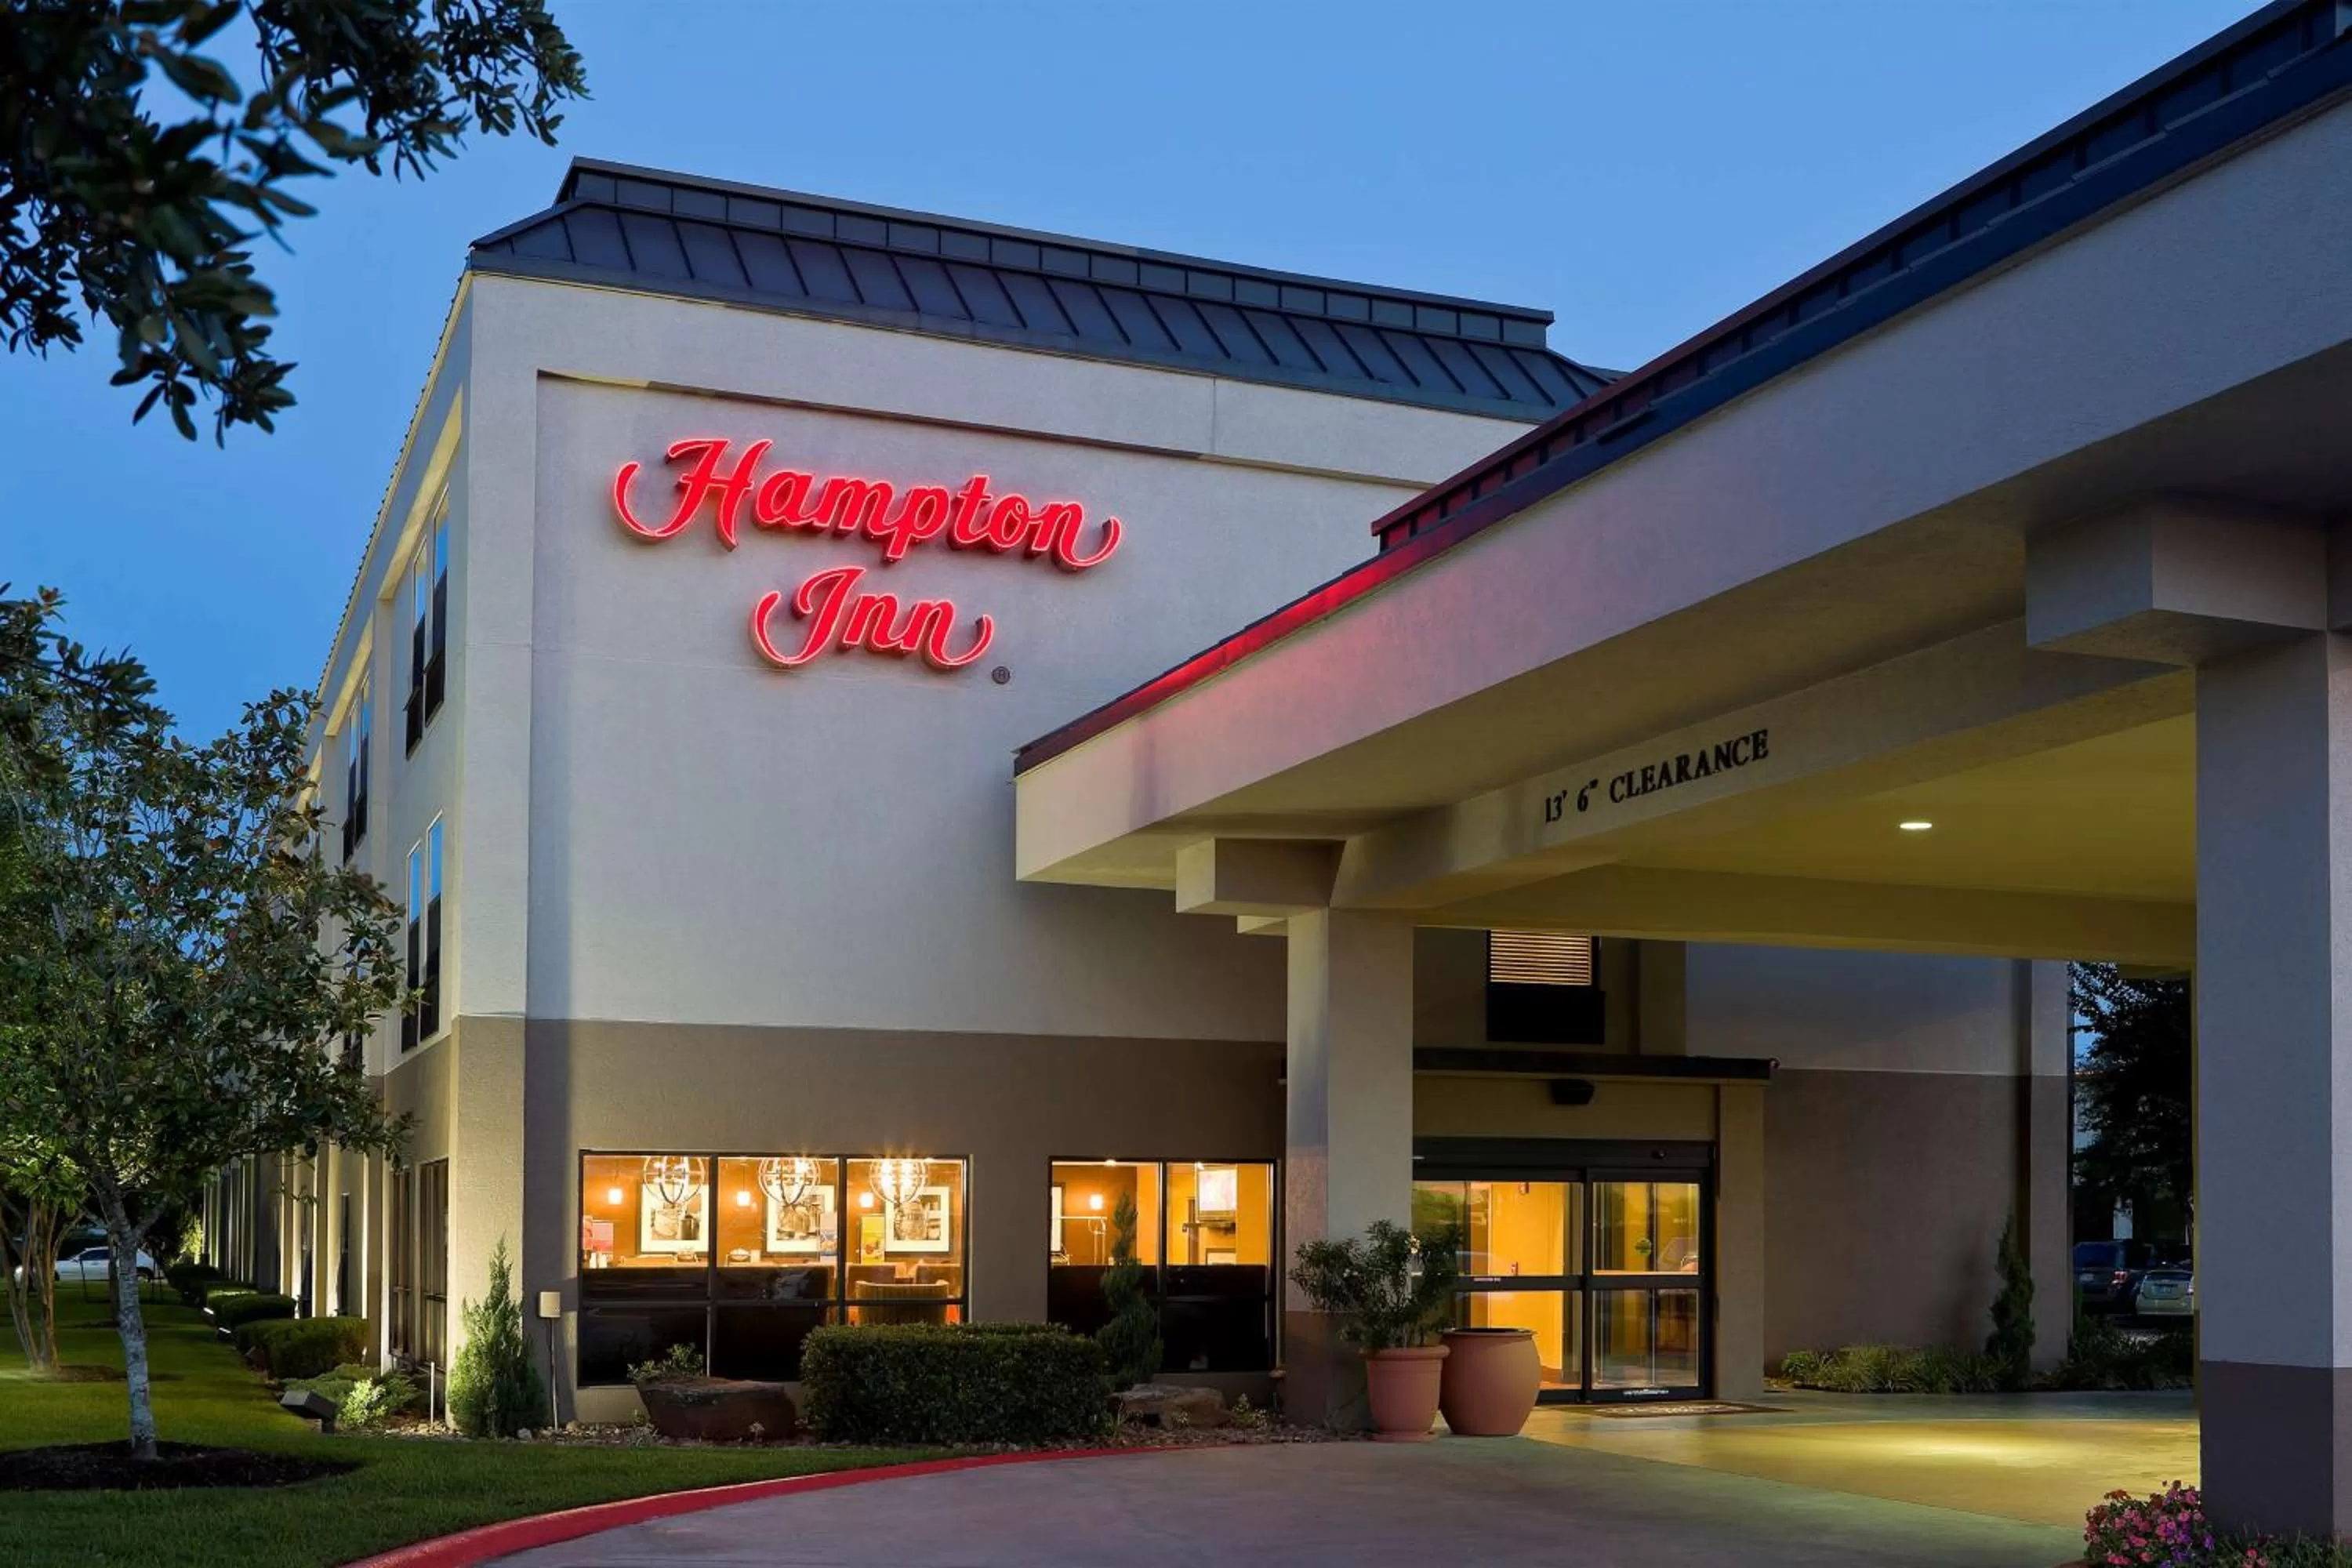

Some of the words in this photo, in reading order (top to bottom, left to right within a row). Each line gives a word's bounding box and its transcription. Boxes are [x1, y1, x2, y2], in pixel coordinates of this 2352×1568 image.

[614, 438, 1122, 568] Hampton
[753, 565, 995, 668] Inn
[1609, 728, 1769, 804] CLEARANCE
